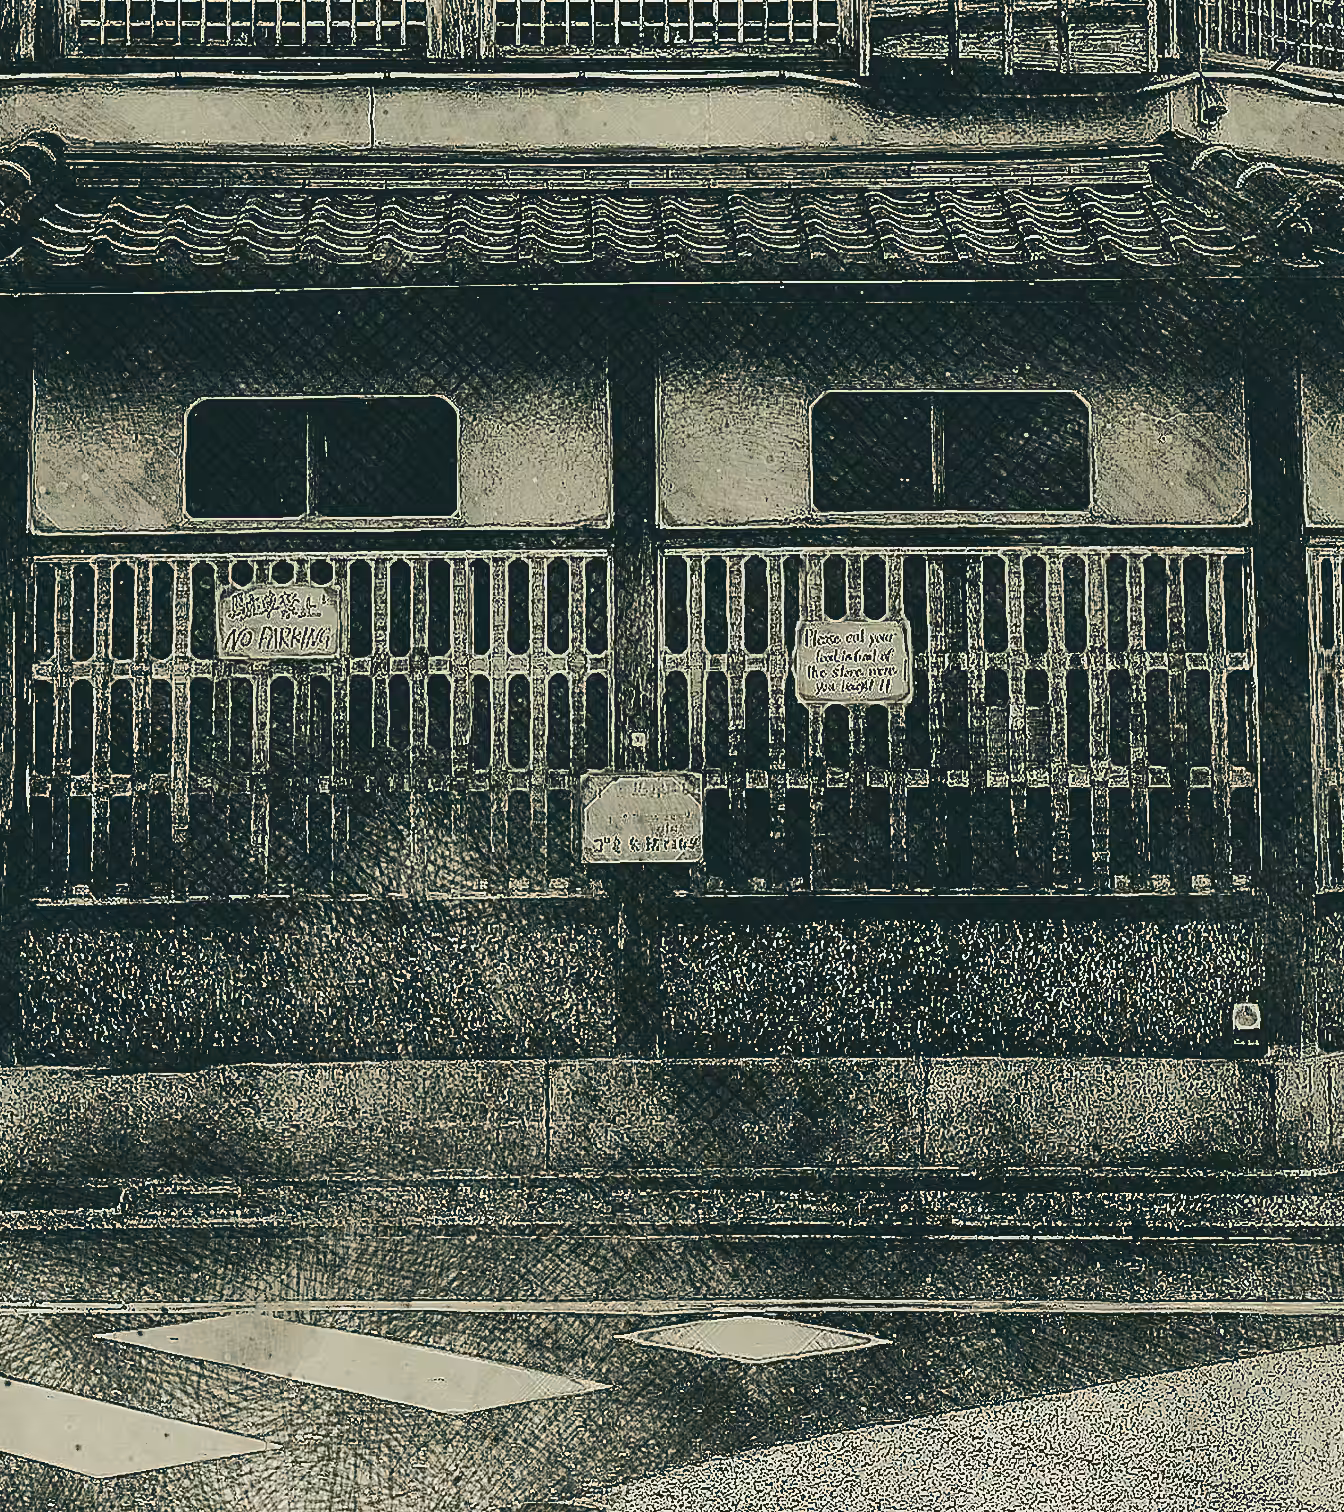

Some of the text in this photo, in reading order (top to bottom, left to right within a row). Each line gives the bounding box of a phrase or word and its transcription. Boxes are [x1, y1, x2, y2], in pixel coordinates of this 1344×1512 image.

[223, 624, 331, 651] NO PARKING
[804, 628, 898, 648] Please eat your
[807, 664, 828, 680] the
[831, 663, 864, 679] store
[815, 680, 836, 696] you
